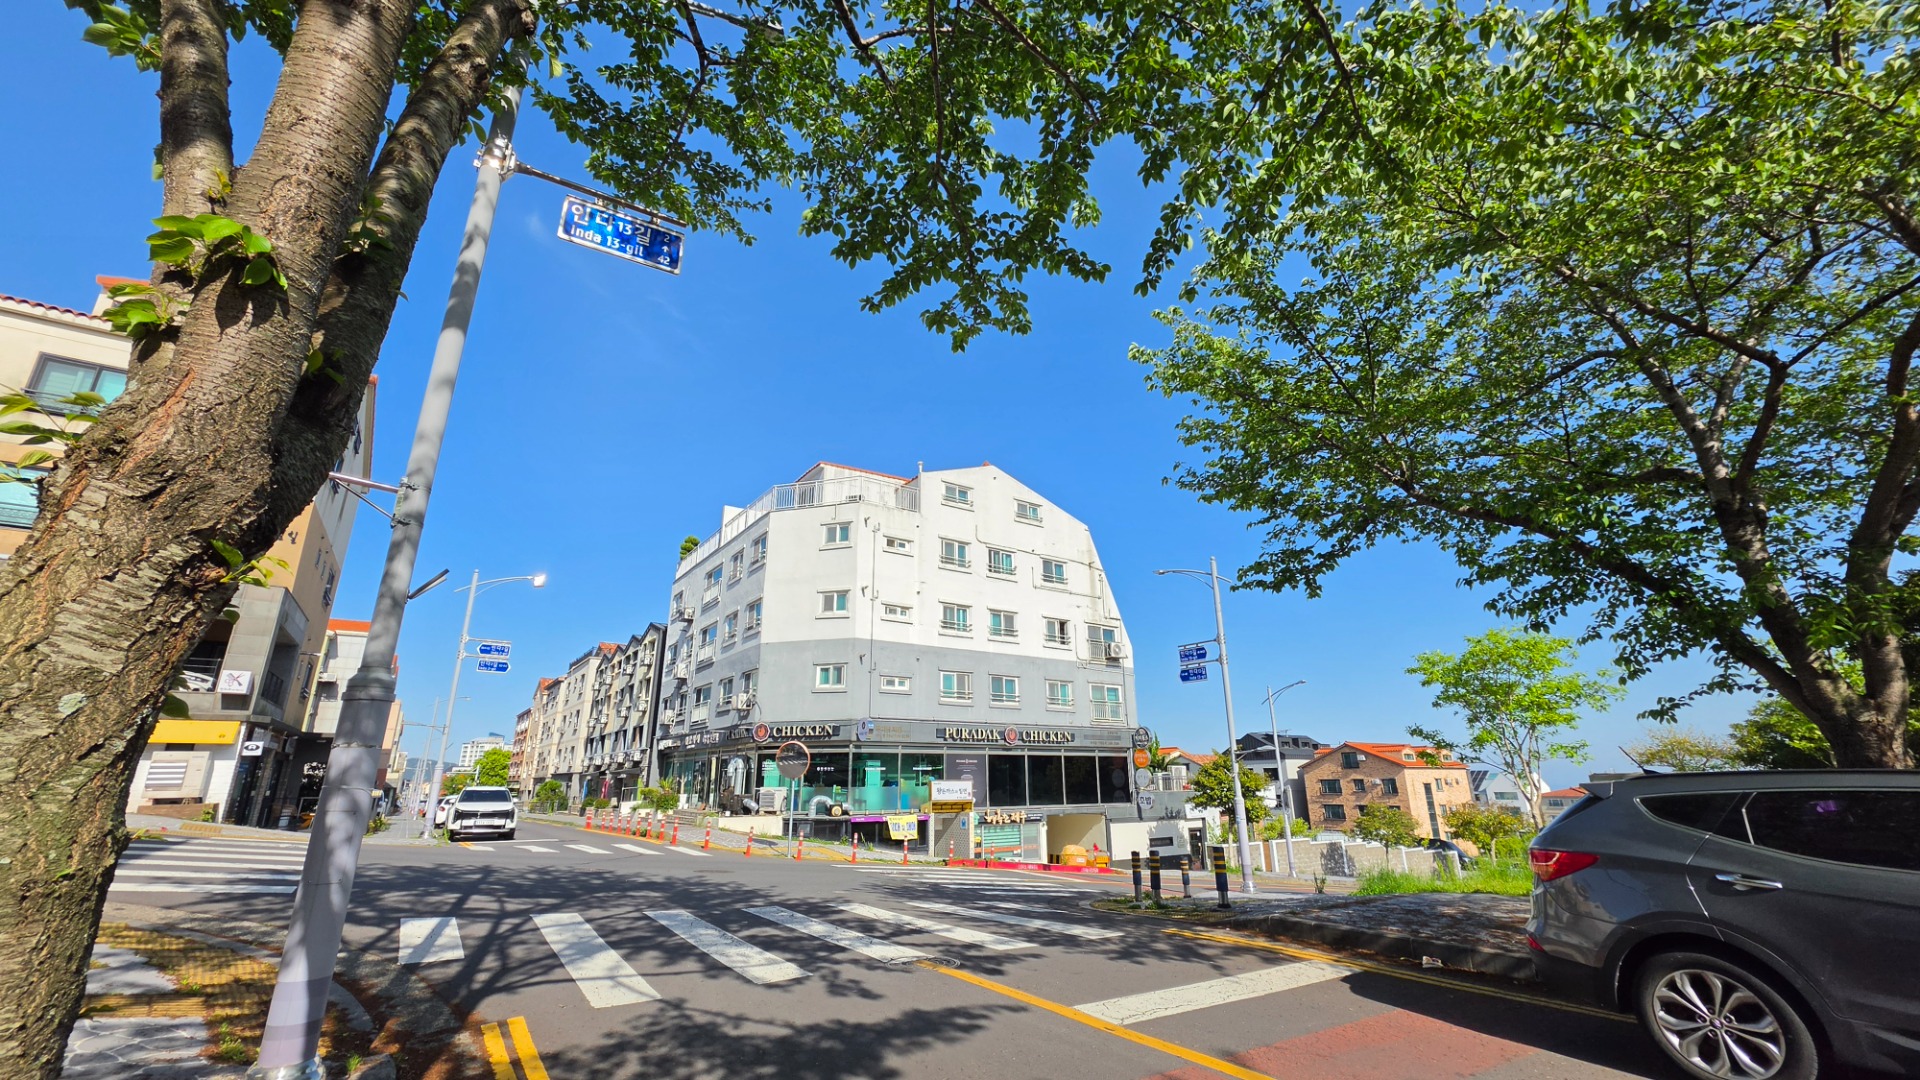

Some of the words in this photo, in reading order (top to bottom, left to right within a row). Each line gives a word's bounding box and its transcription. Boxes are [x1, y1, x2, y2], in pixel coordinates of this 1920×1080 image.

[571, 204, 652, 247] 인다13길
[571, 224, 602, 244] Inda
[606, 235, 645, 258] 13-gil
[663, 234, 671, 243] 2
[657, 254, 671, 266] 42
[773, 725, 833, 737] CHICKEN
[945, 727, 1000, 739] PURADAK
[1022, 730, 1071, 742] CHICKEN
